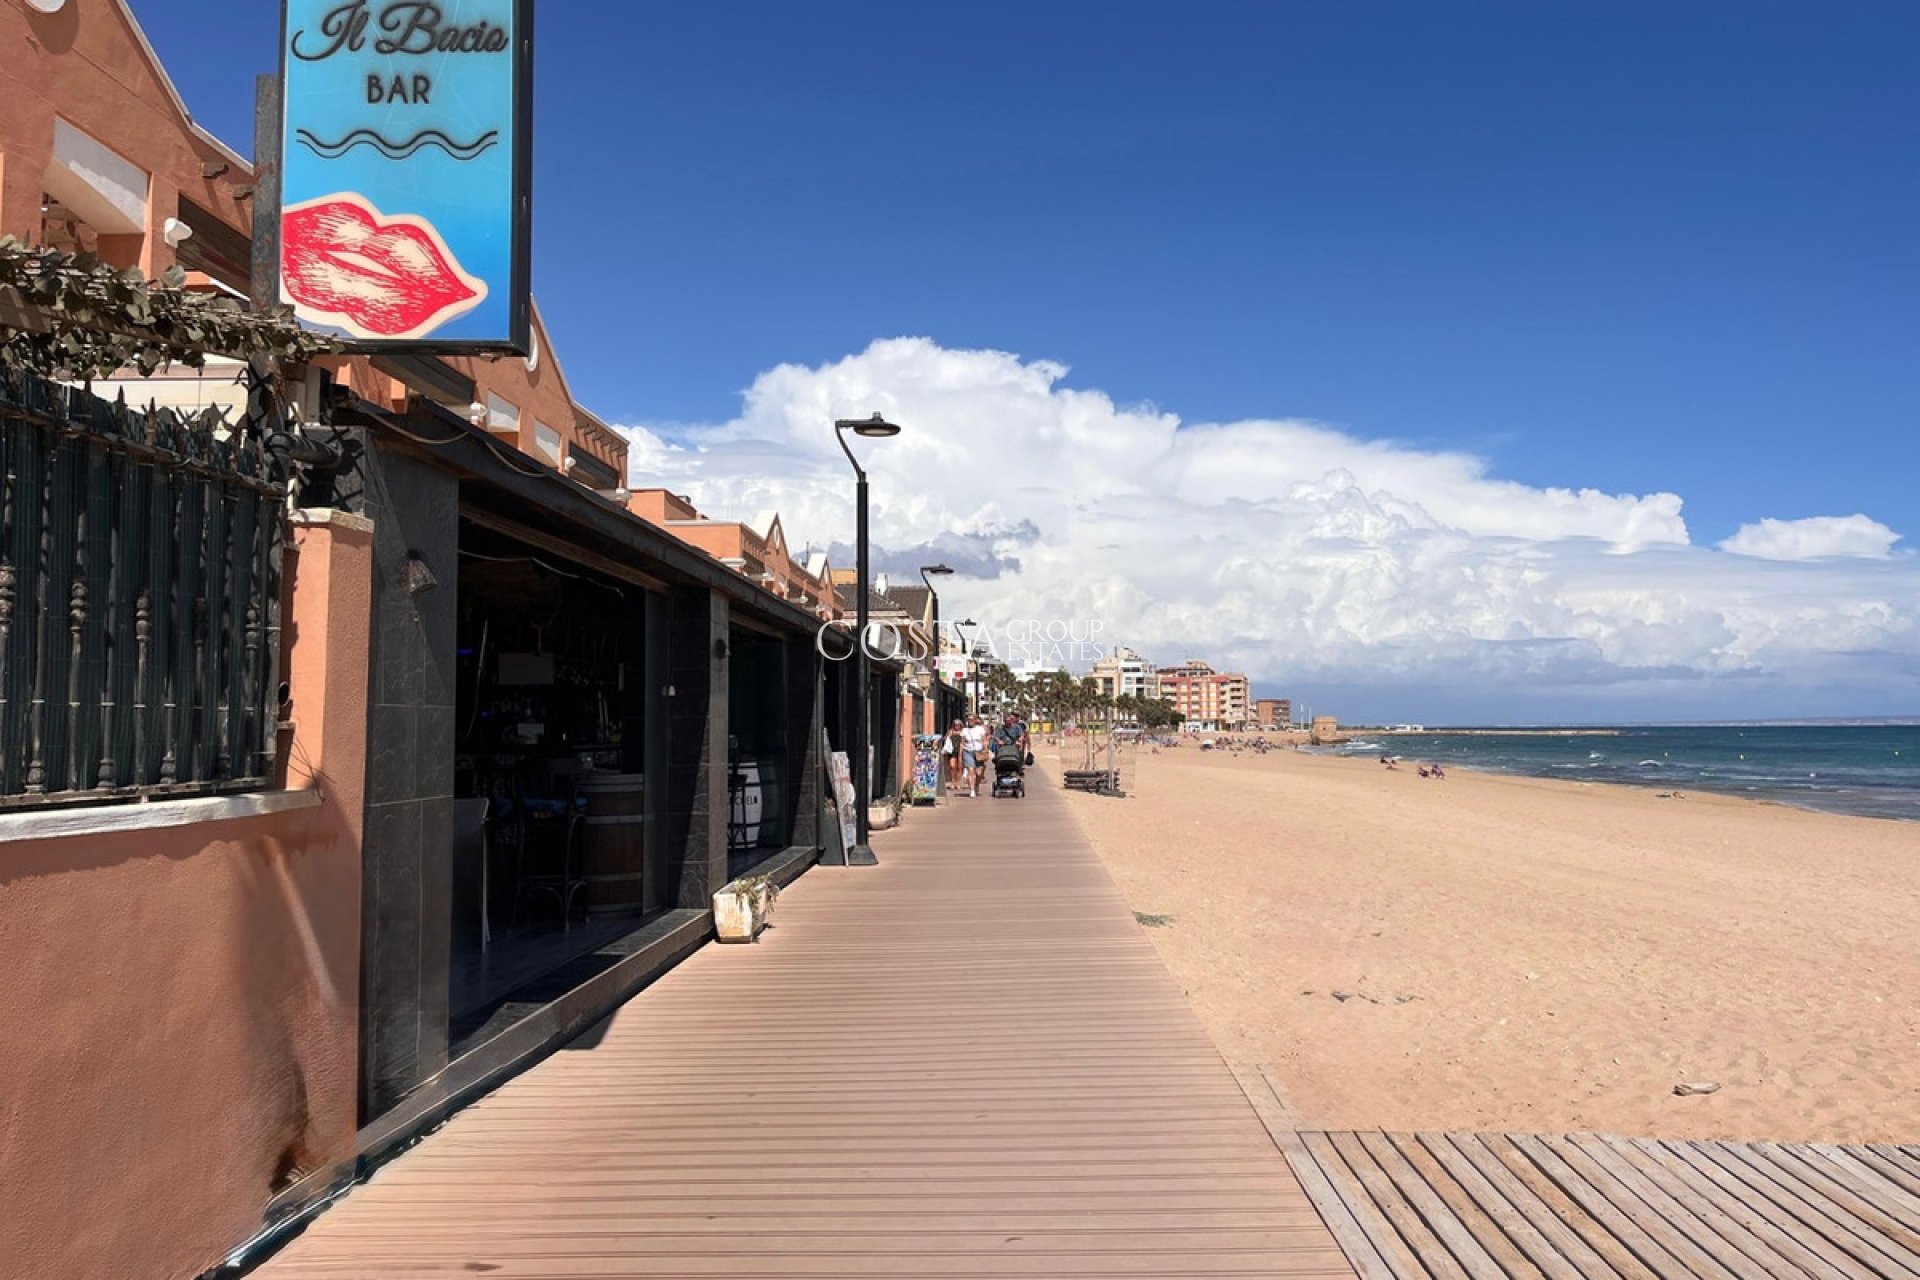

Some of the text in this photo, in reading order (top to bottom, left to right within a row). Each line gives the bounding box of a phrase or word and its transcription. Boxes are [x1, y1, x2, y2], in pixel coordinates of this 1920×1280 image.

[291, 0, 509, 61] Il Bacio
[366, 74, 431, 104] BAR
